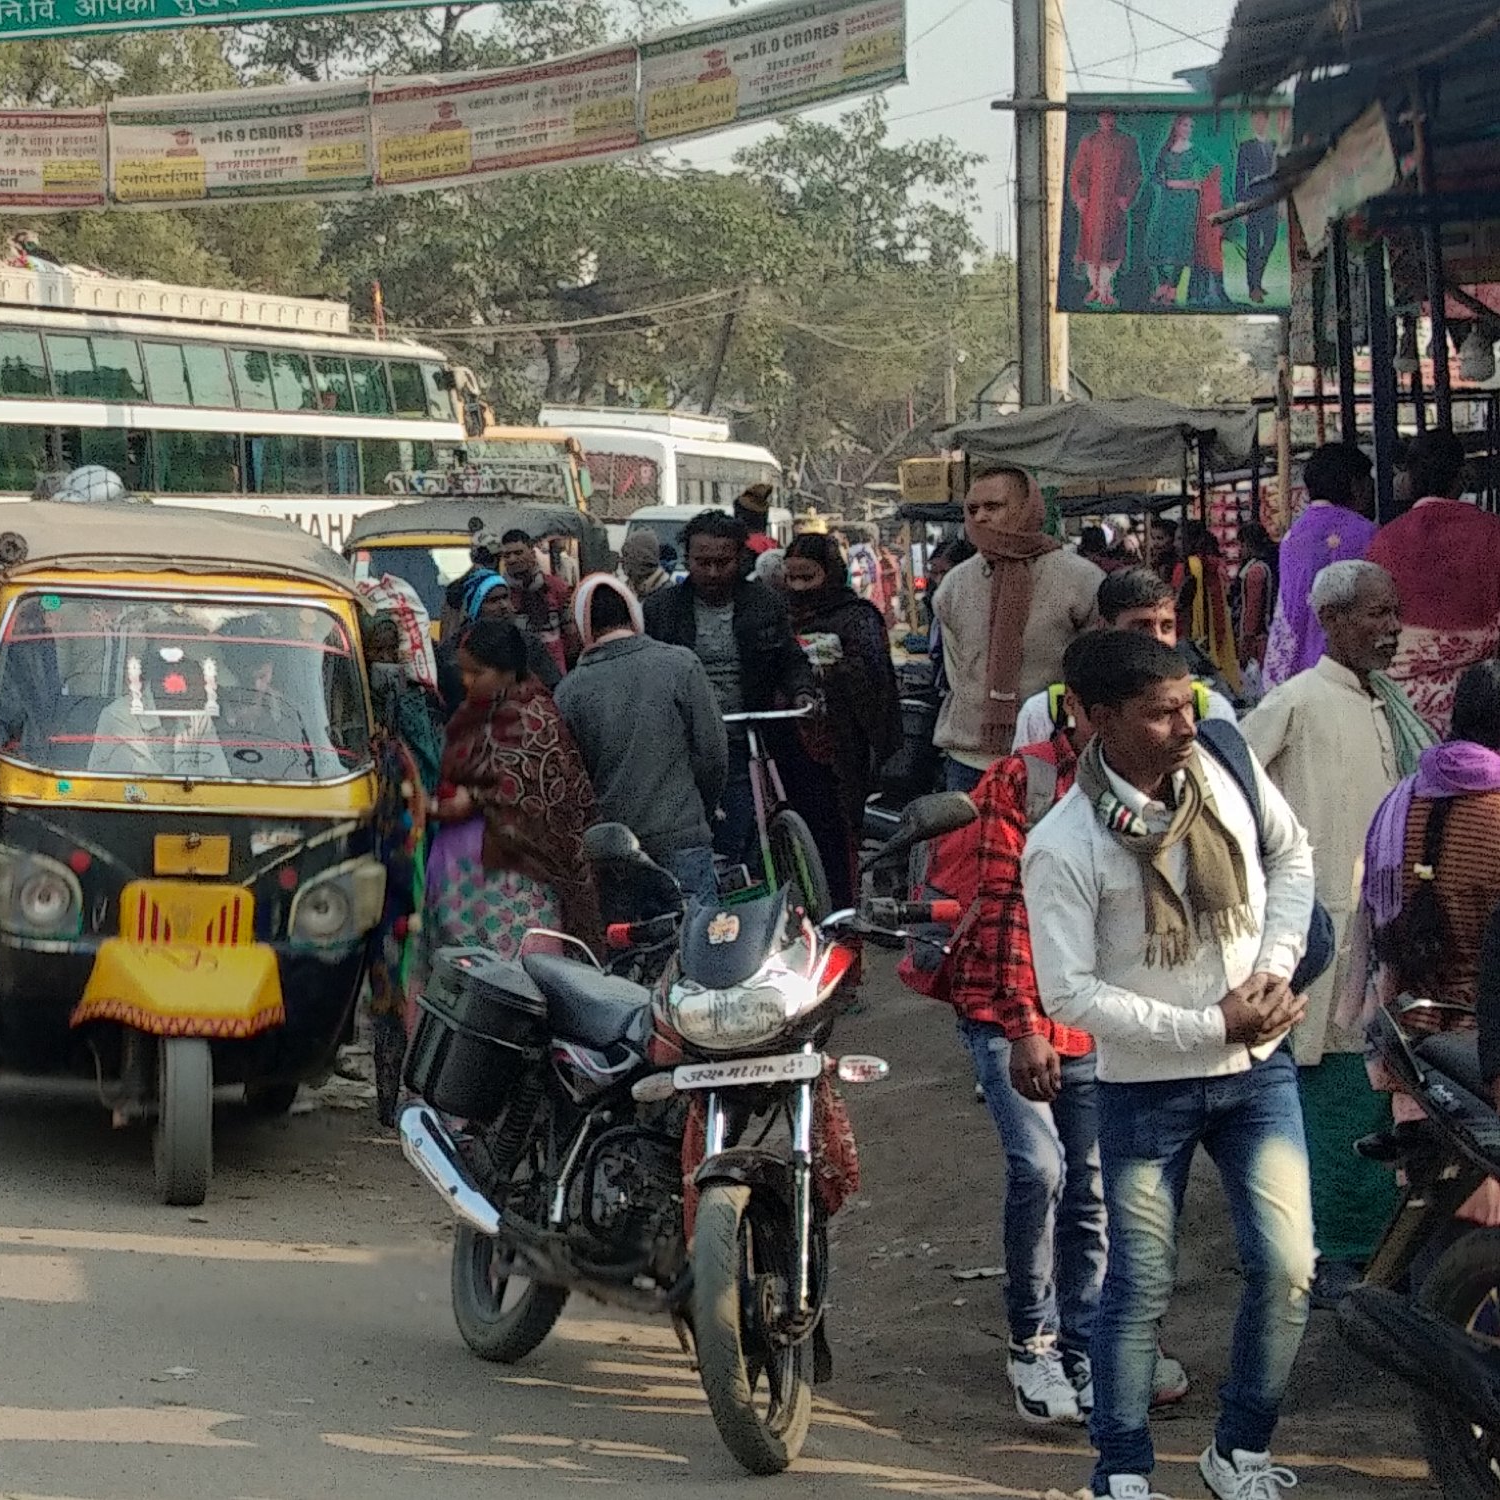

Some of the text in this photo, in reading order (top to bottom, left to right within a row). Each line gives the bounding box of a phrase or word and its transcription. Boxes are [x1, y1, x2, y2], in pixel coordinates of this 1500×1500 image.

[784, 22, 839, 49] CRORES
[217, 129, 245, 143] 16.9
[249, 123, 304, 141] CRORES
